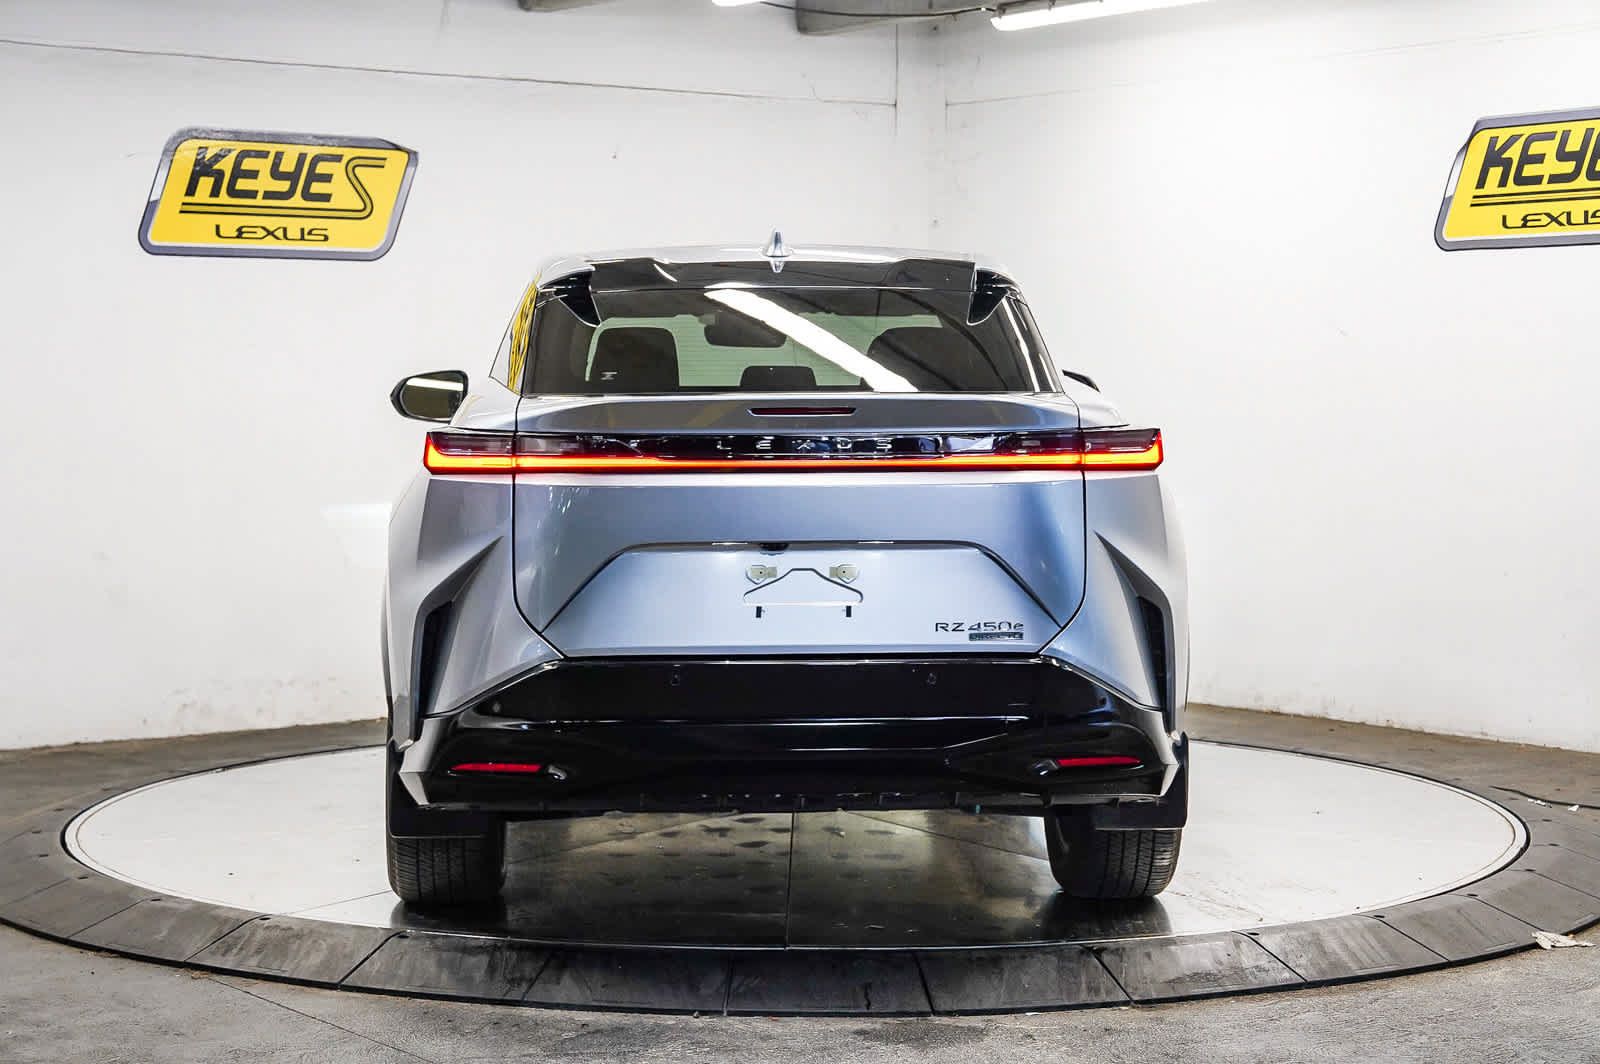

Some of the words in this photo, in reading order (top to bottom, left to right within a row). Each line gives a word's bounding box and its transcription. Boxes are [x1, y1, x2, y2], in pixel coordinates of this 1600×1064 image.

[182, 146, 388, 219] KEYES
[215, 223, 329, 242] LEXUS
[716, 436, 893, 450] LEXUS
